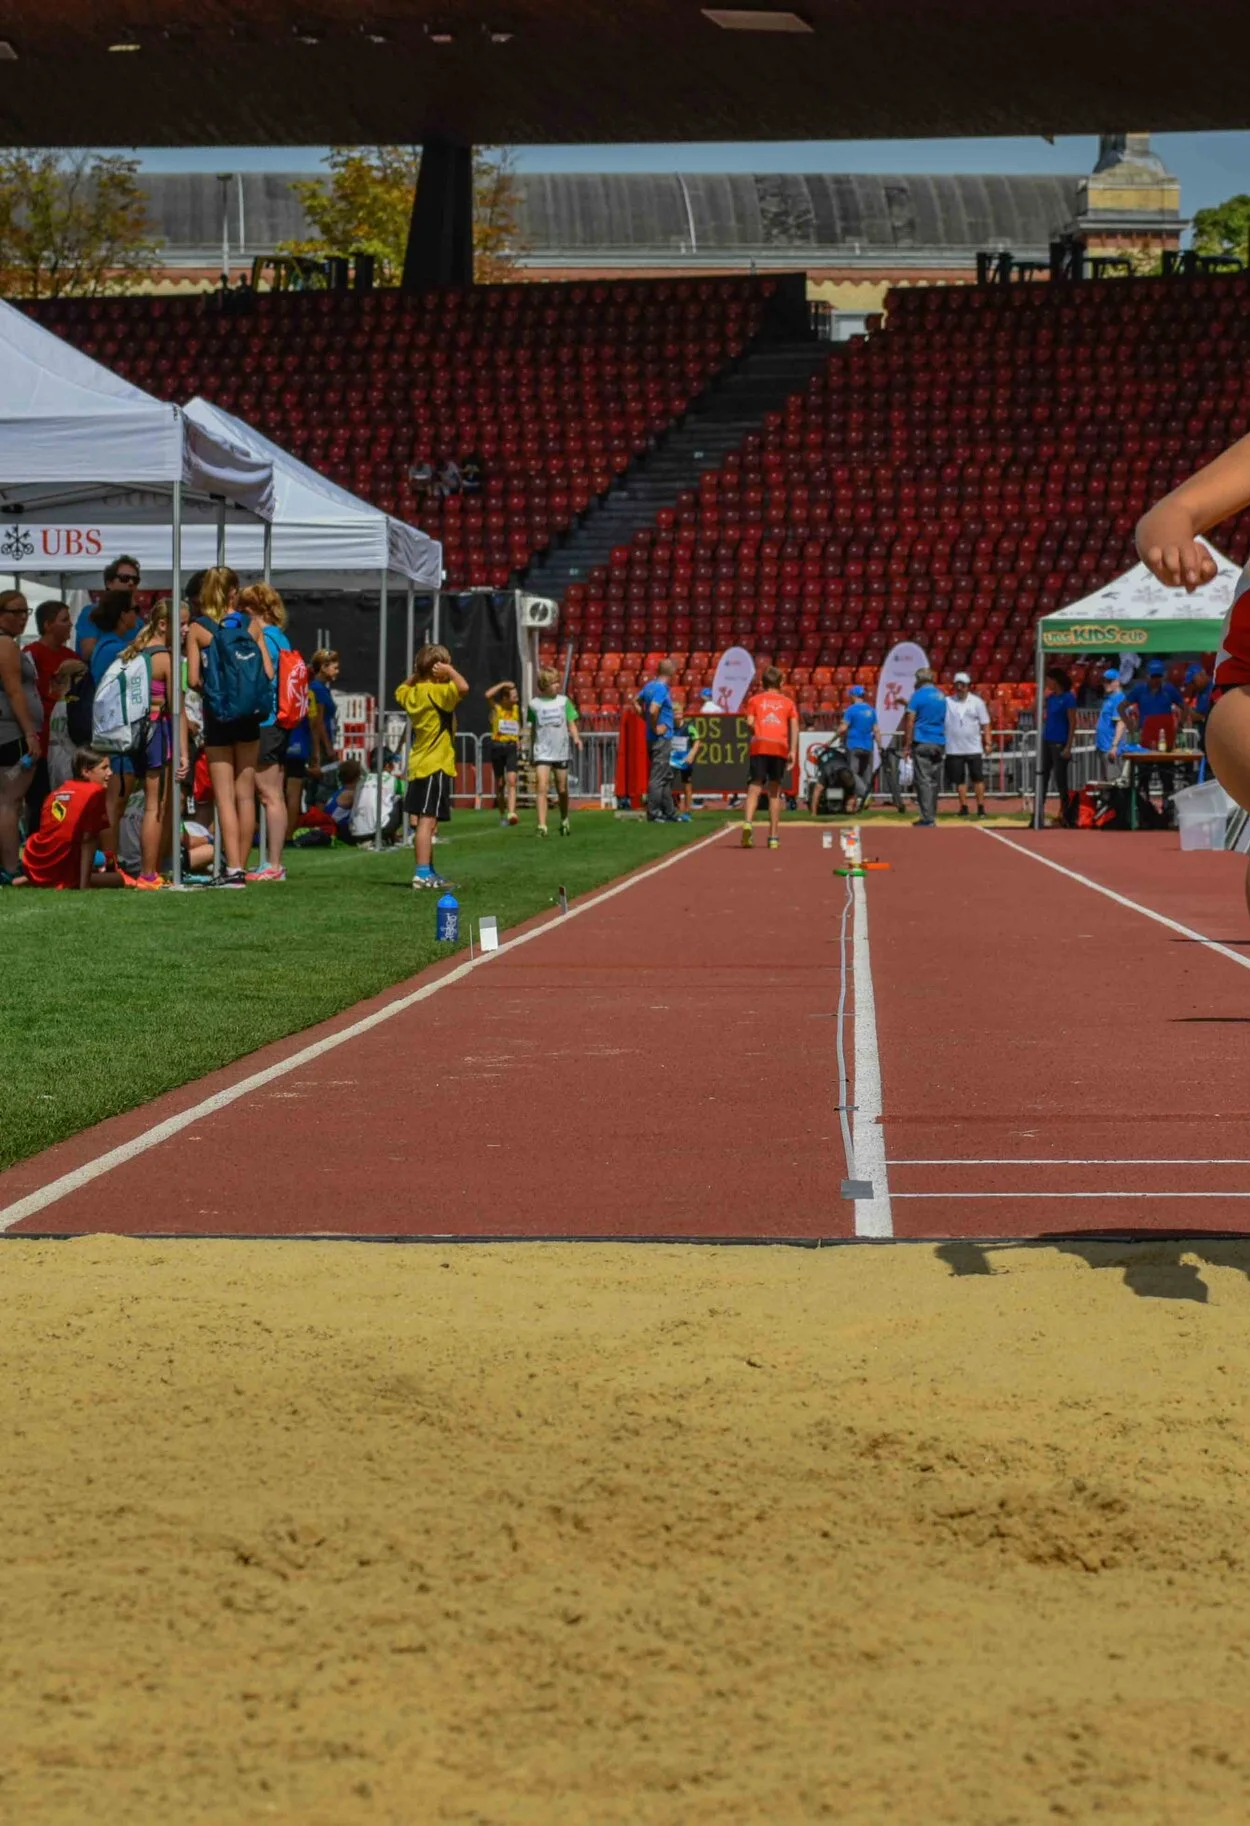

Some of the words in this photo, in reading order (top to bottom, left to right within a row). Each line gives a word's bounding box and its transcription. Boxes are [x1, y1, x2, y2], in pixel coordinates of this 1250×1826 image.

[42, 528, 103, 555] UBS
[1072, 626, 1118, 643] KIDS
[1119, 630, 1147, 643] CUP
[684, 717, 721, 738] DS
[696, 743, 749, 764] 2017
